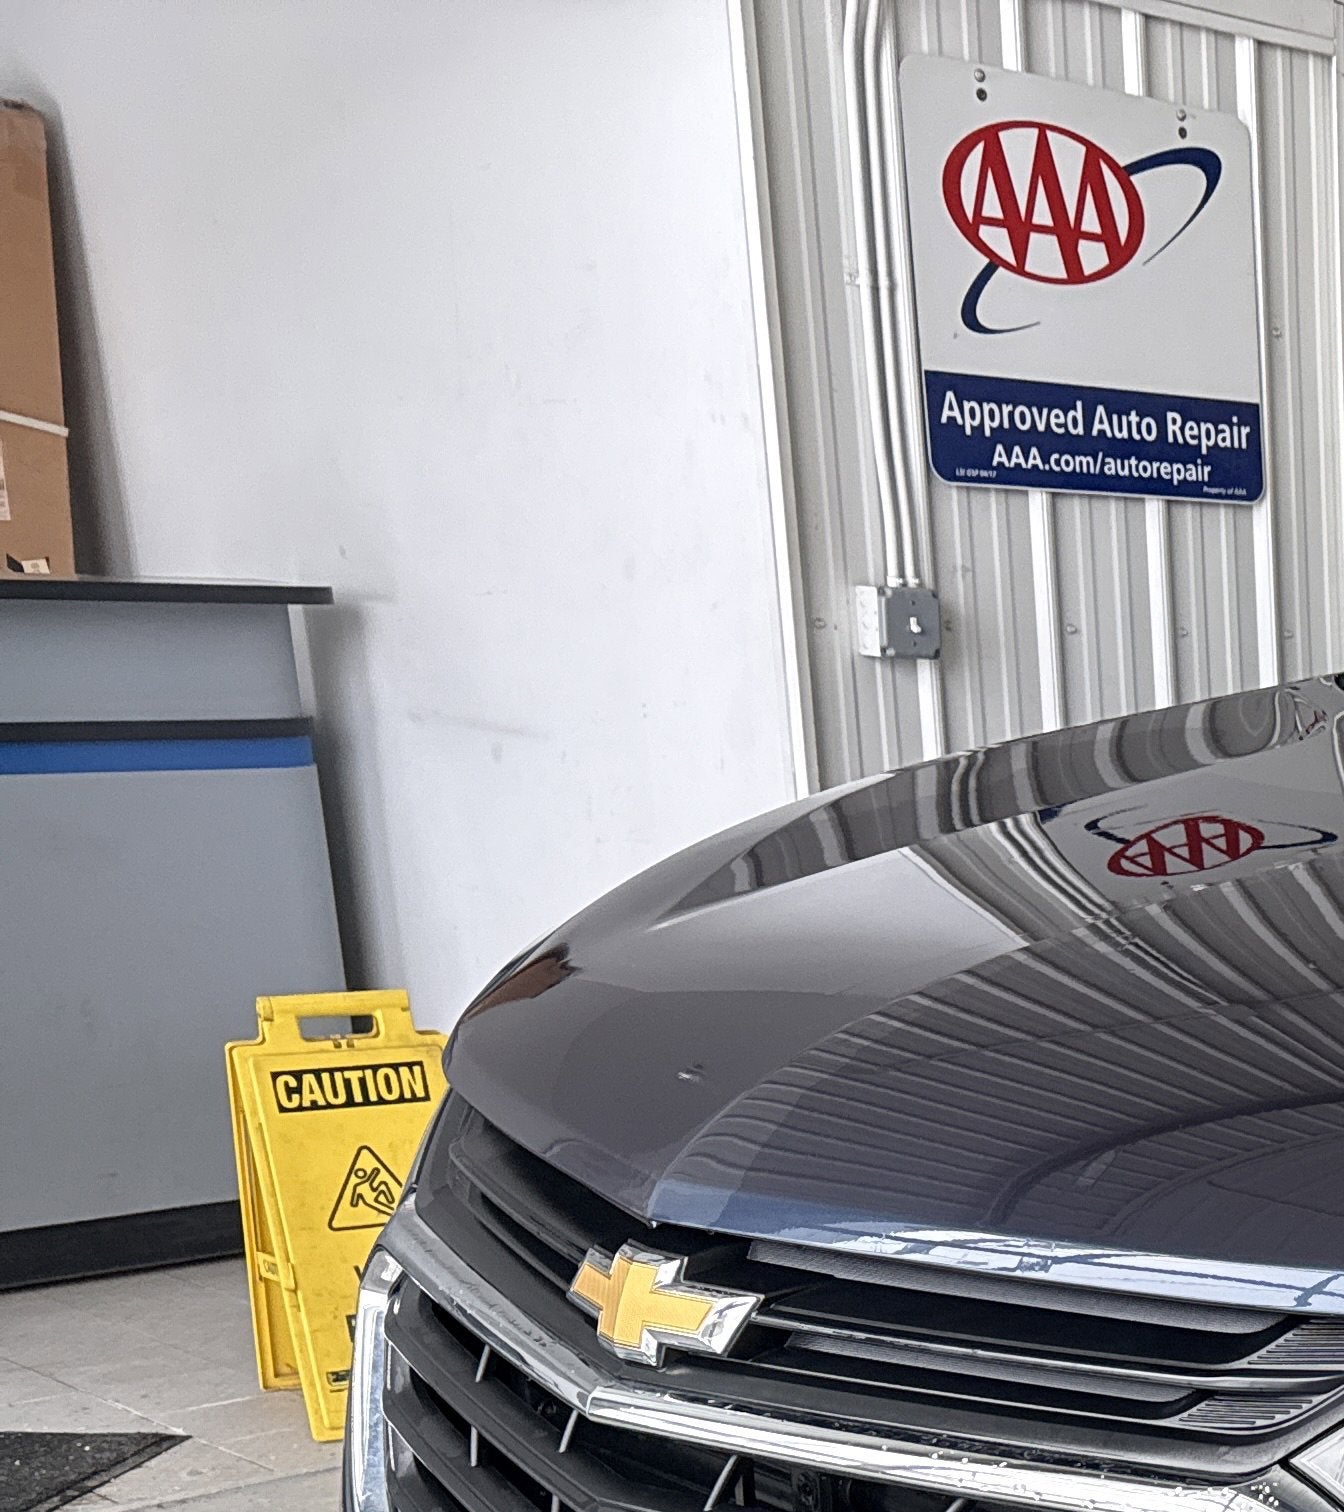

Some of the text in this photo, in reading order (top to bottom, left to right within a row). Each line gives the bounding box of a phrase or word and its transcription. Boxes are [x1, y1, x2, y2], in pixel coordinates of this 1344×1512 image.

[950, 121, 1138, 284] AAA
[940, 390, 1250, 455] Approved Auto Repair
[992, 443, 1212, 486] AAA.com/autorepair
[275, 1065, 426, 1109] CAUTION
